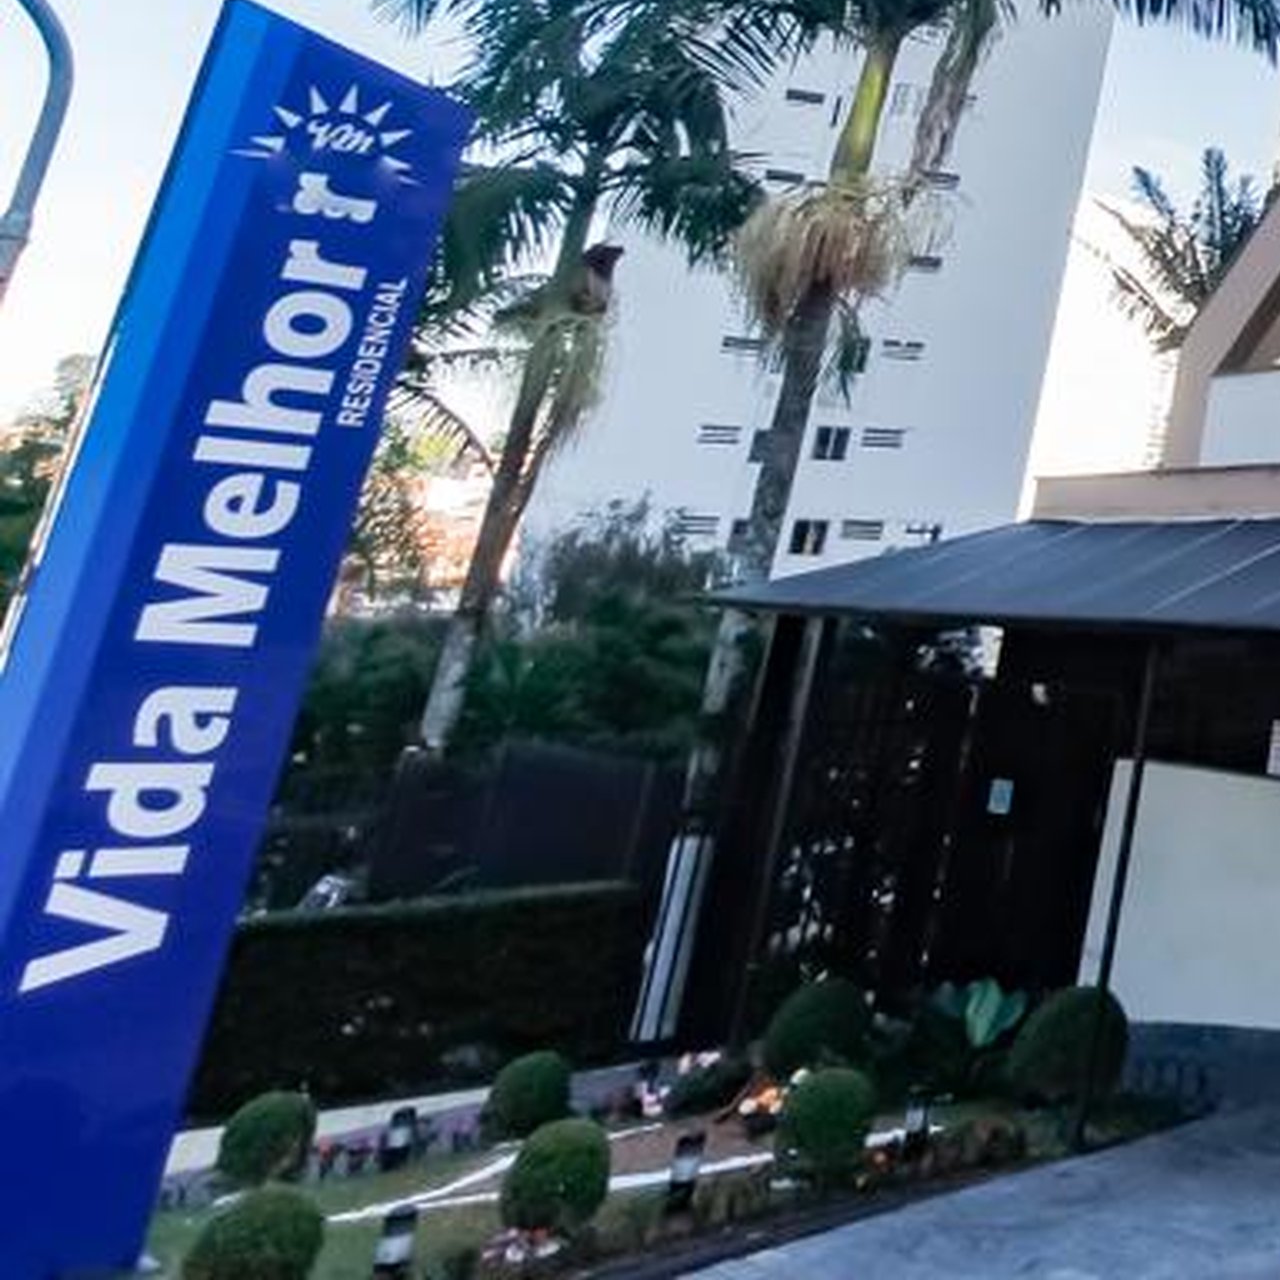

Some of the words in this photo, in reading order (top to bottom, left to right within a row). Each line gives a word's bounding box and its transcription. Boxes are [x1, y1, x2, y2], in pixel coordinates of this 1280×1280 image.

[336, 276, 408, 428] RESIDENCIAL
[18, 686, 238, 993] Vida
[134, 239, 367, 647] Melhor
